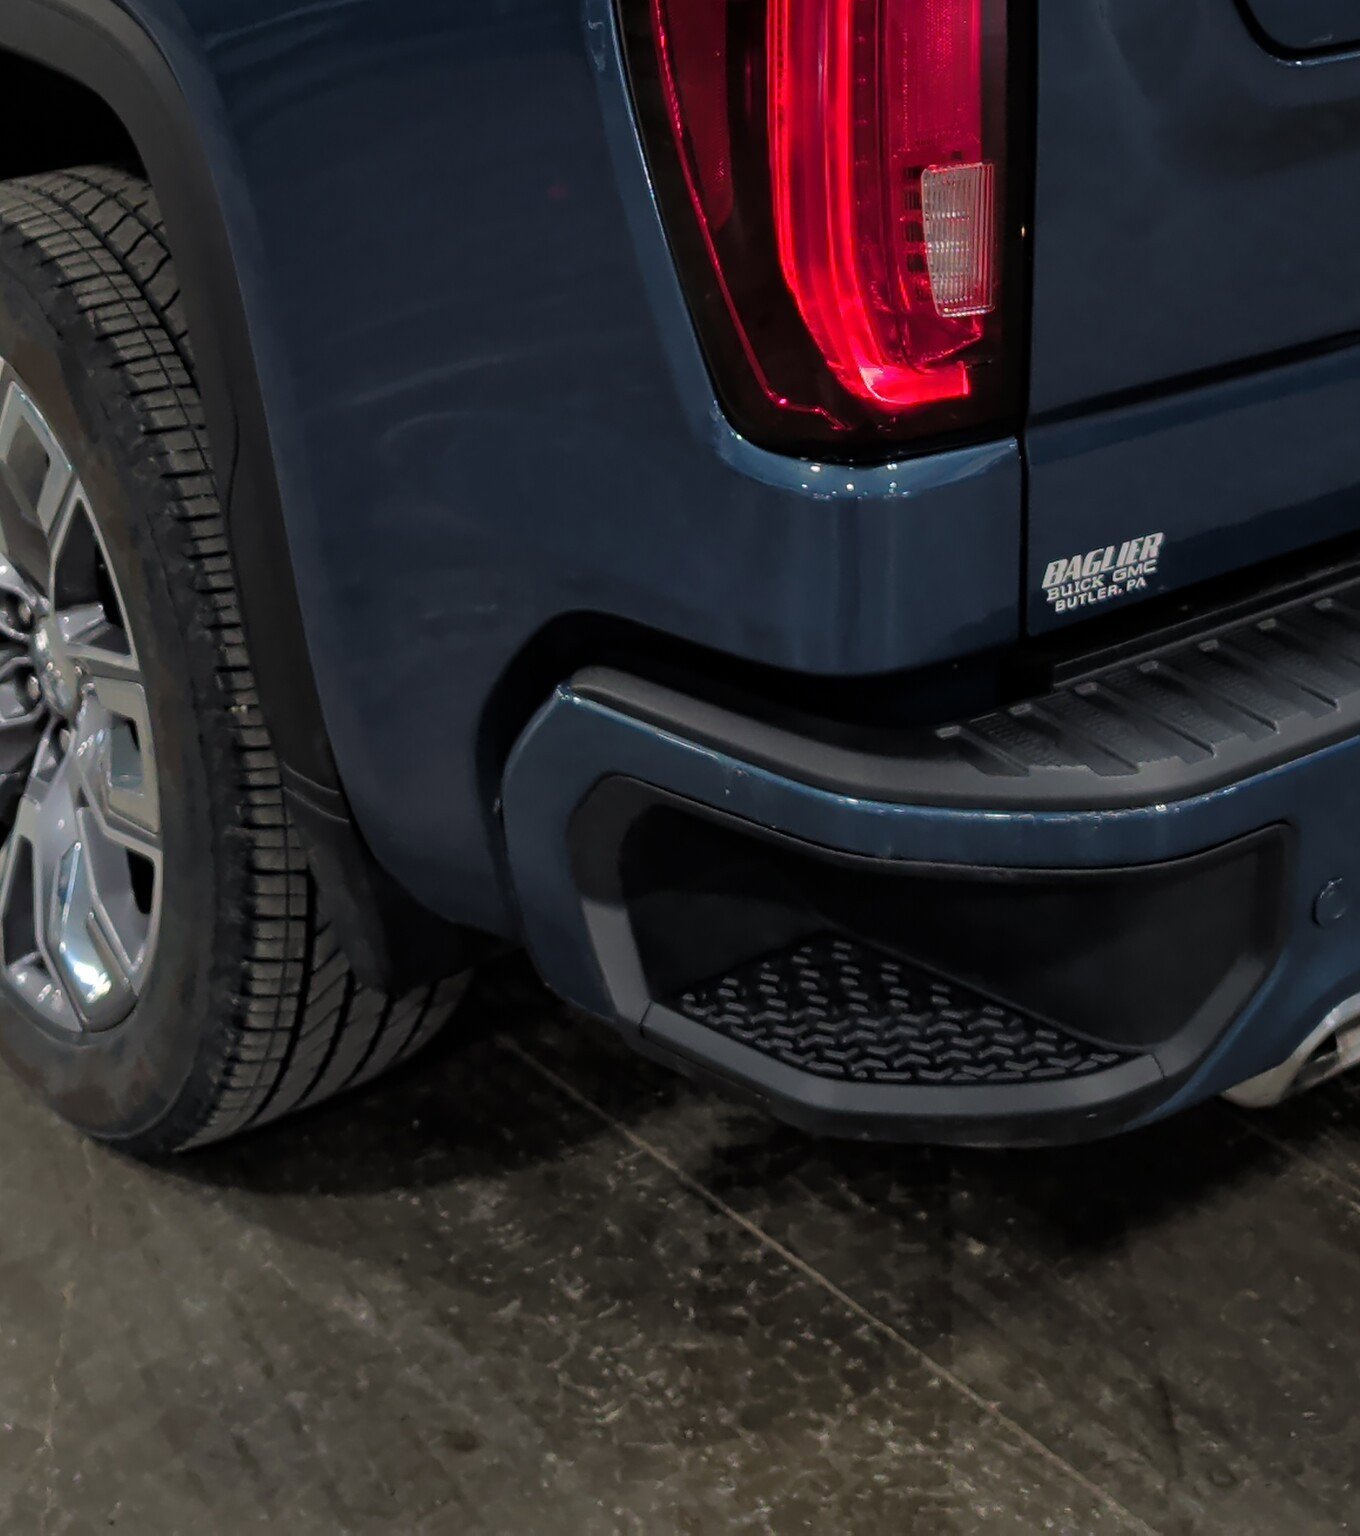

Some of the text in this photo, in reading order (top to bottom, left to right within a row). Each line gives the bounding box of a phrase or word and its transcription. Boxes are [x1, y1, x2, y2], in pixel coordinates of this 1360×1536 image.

[1041, 532, 1165, 589] BAGLIER
[1046, 559, 1158, 602] BUICK GMC
[1126, 576, 1148, 593] PA
